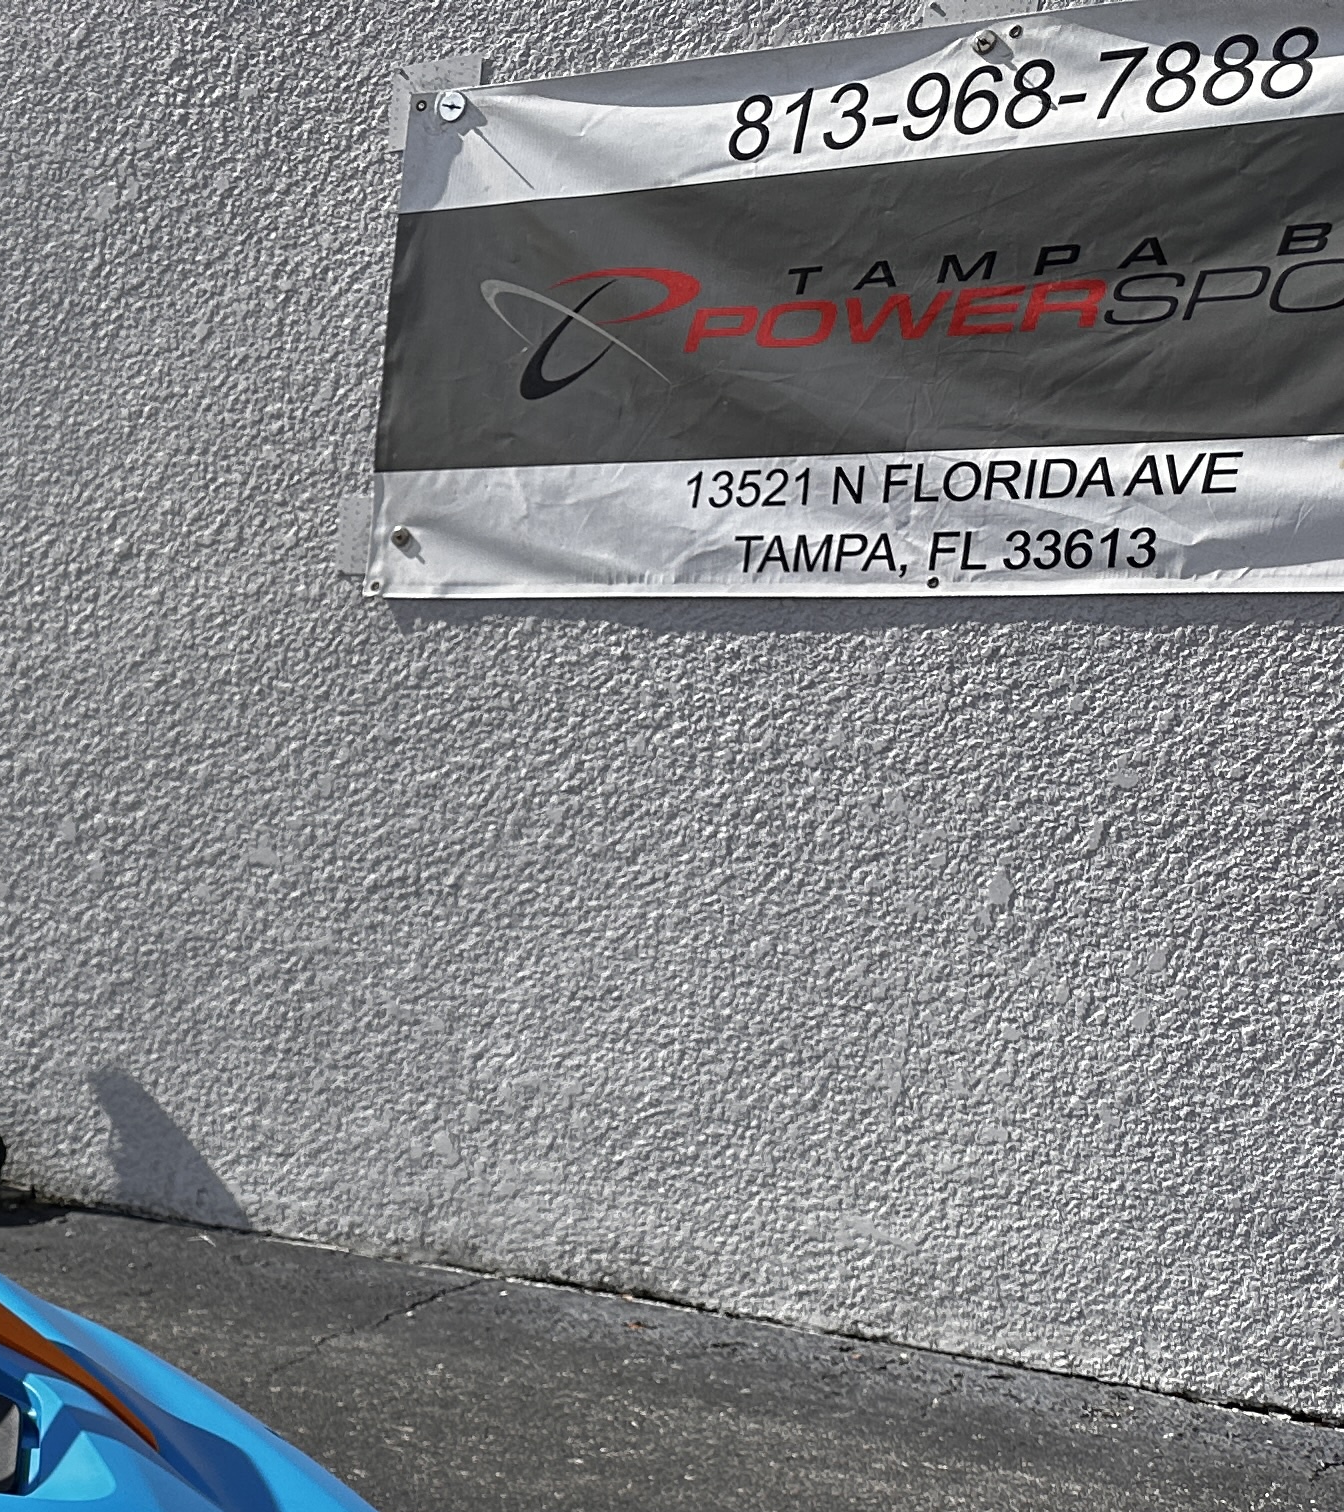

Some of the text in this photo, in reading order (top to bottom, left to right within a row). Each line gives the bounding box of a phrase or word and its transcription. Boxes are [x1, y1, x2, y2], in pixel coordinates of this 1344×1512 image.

[728, 26, 1319, 161] 813-968-7888
[788, 222, 1333, 296] TAMPA B
[686, 451, 1244, 509] 13521 N FLORIDA AVE
[734, 527, 1157, 579] TAMPA, FL 33613
